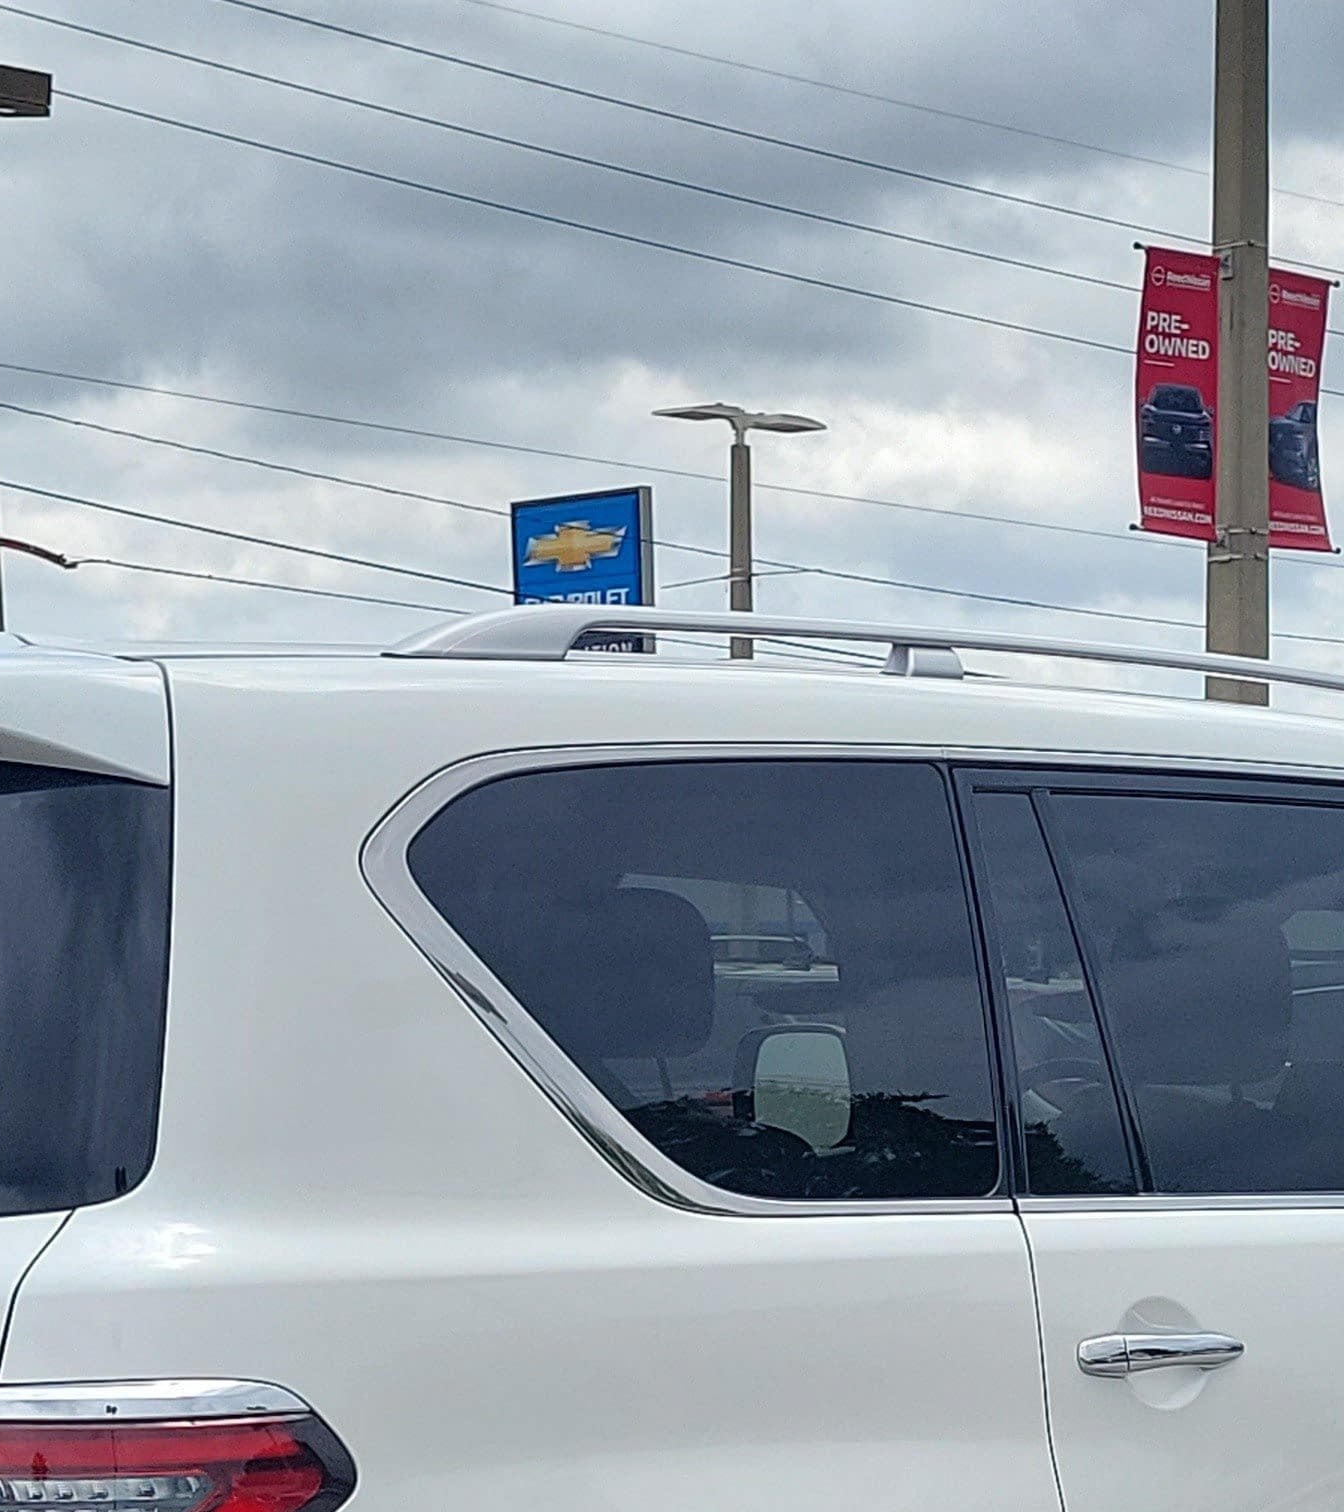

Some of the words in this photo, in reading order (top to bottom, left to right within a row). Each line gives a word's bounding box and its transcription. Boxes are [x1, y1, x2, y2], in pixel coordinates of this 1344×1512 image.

[1146, 311, 1190, 334] PRE-
[1144, 335, 1210, 360] OWNED
[1268, 329, 1301, 352] PRE-
[1268, 351, 1316, 378] OWNED
